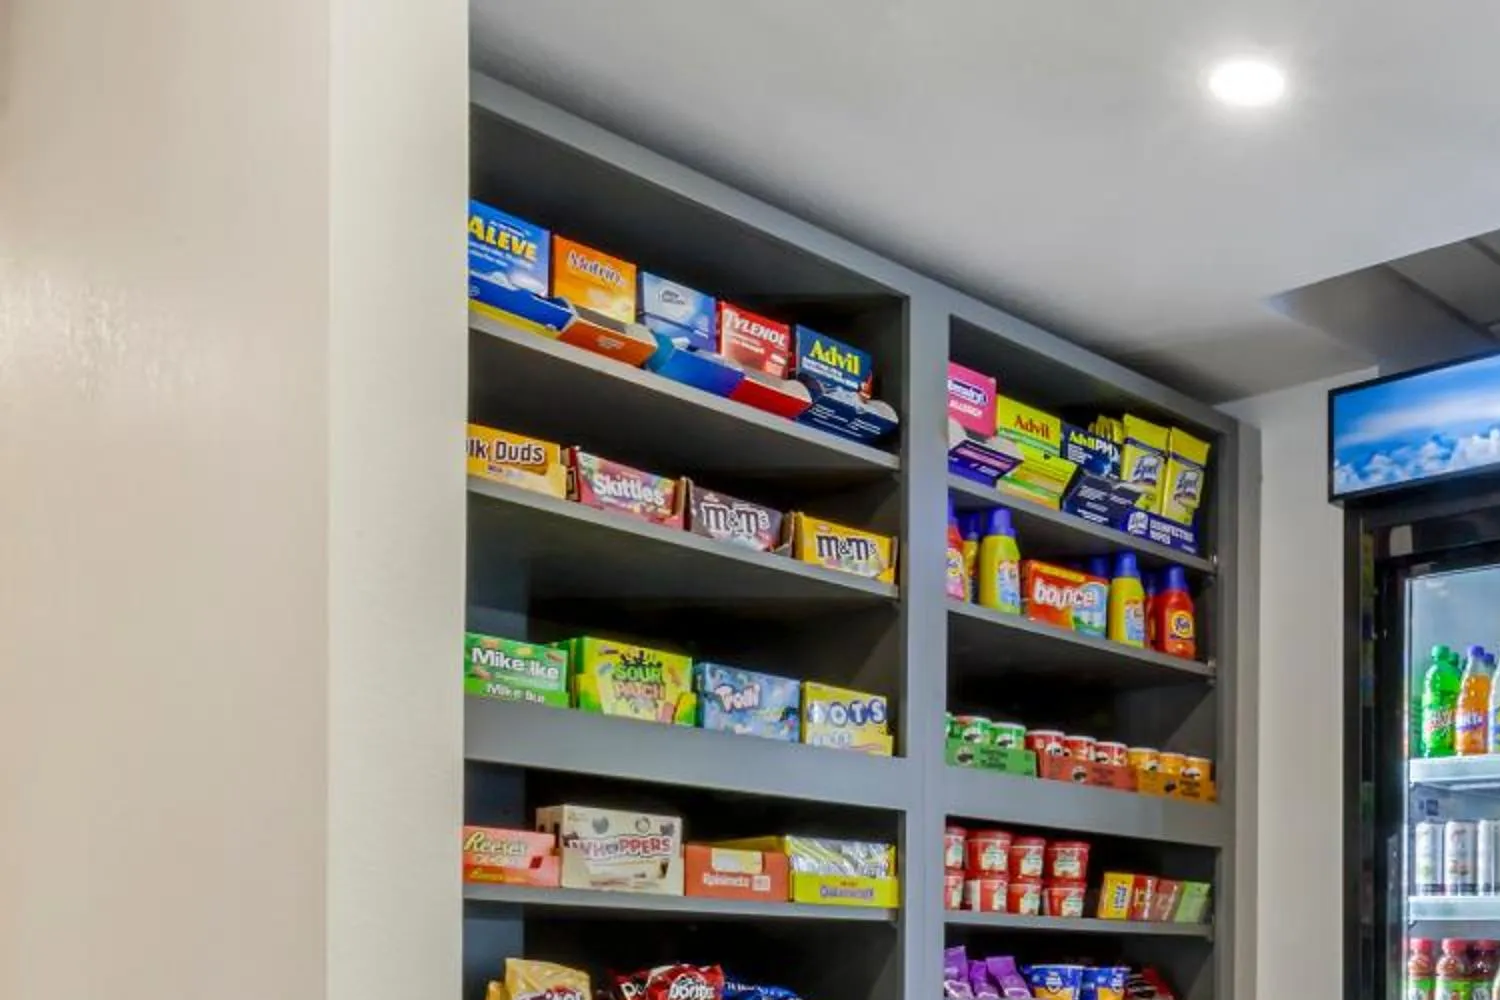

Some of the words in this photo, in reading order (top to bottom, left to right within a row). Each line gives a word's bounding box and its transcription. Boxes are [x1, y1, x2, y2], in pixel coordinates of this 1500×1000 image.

[468, 216, 537, 258] ALEVE
[725, 309, 787, 344] TYLENOL
[809, 339, 861, 375] Advil
[1015, 415, 1051, 439] Advil
[467, 439, 487, 459] ilk
[495, 440, 545, 464] Duds
[593, 474, 666, 506] Skittles
[1034, 577, 1097, 610] bounce
[472, 647, 525, 672] Mike
[529, 660, 560, 680] Ike
[613, 664, 664, 682] SOUR
[570, 836, 673, 859] WHOPPERS
